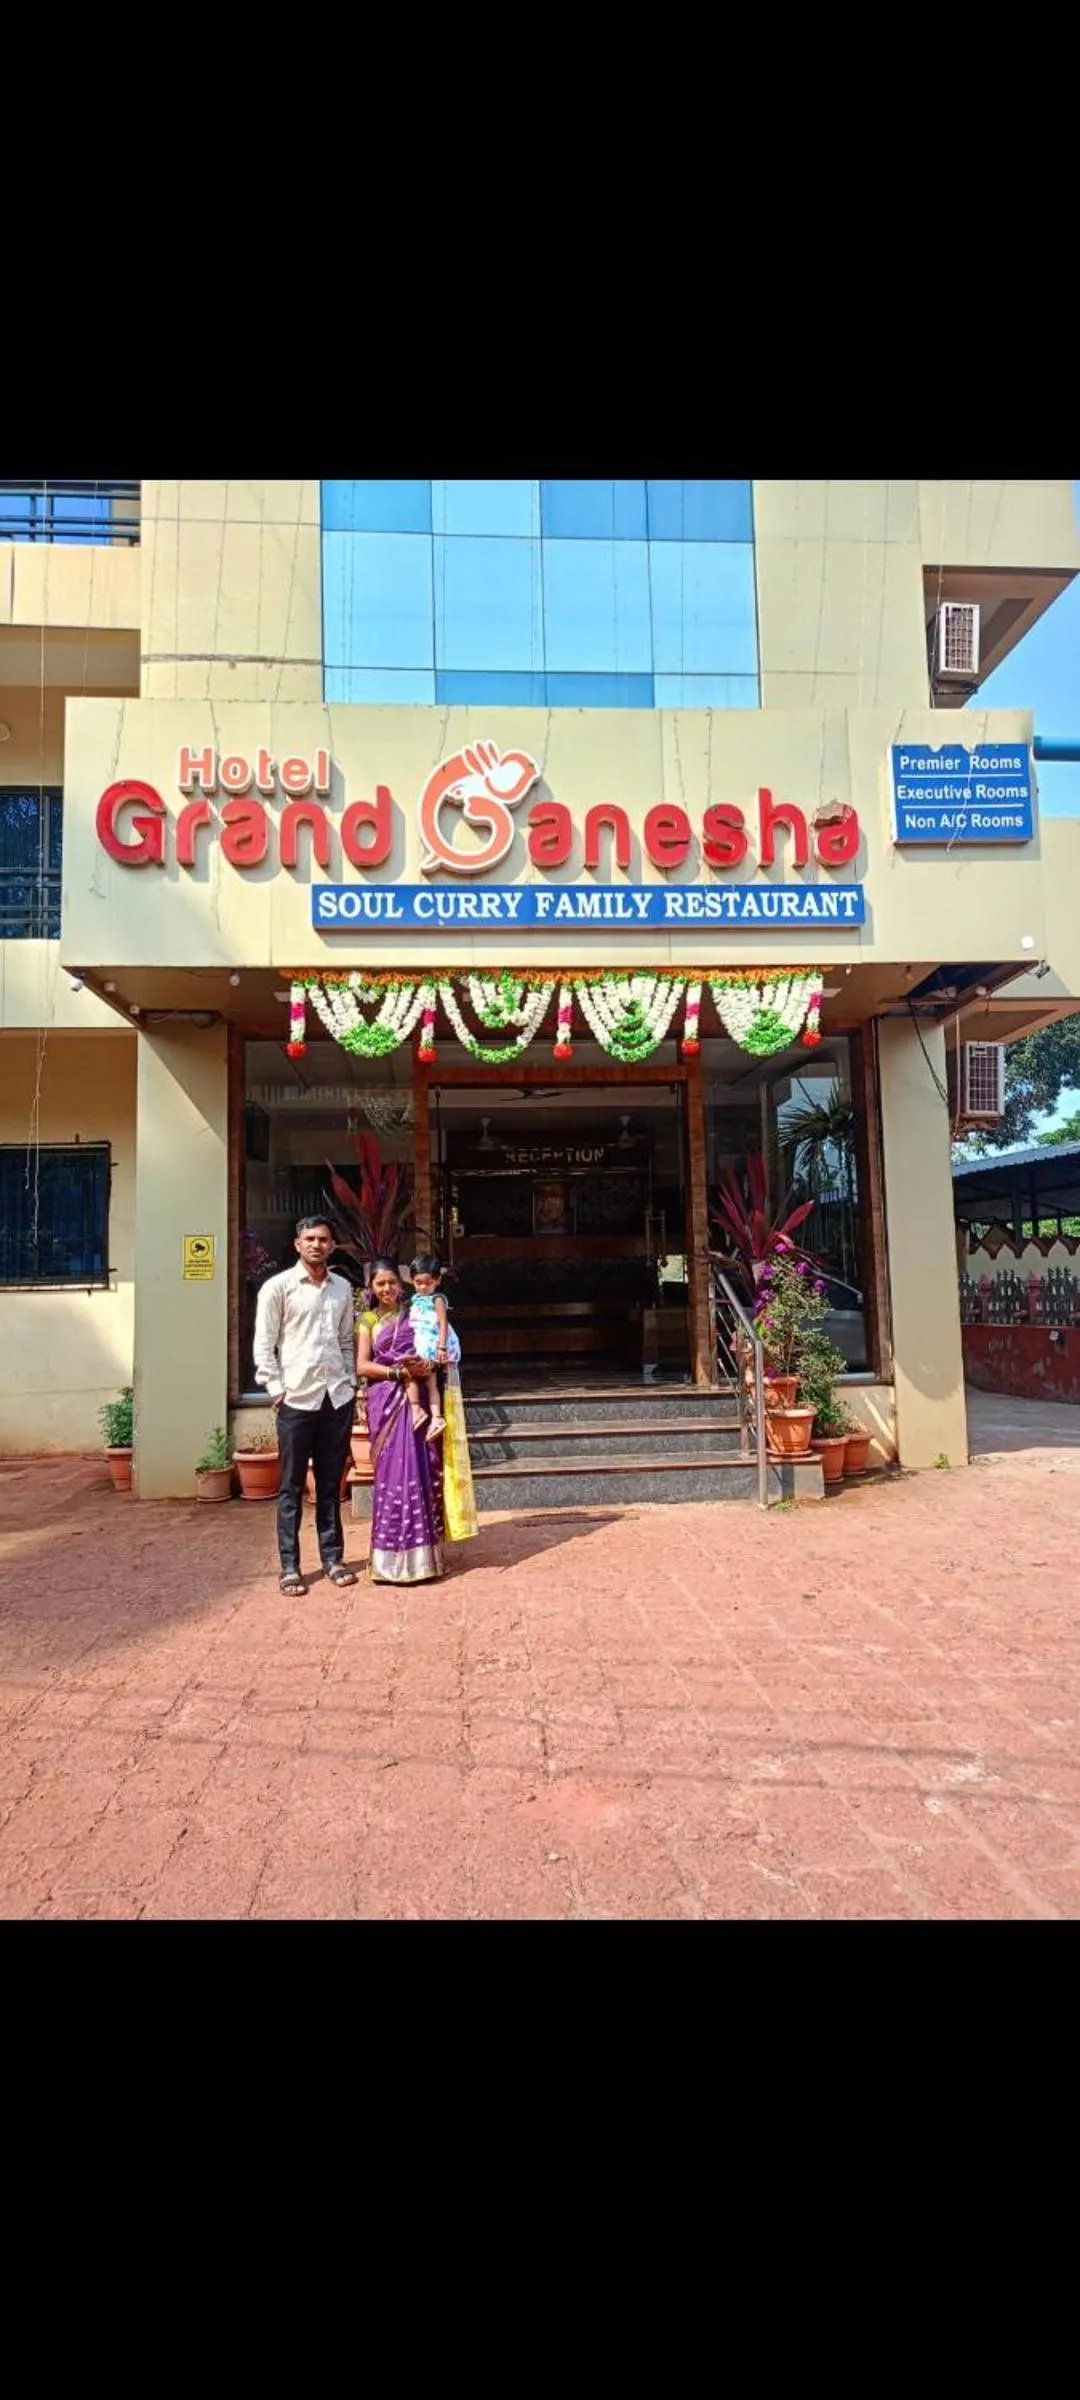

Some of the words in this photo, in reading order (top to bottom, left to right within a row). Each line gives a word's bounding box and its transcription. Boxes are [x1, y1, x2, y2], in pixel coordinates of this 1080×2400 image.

[178, 746, 331, 794] Hotel
[900, 755, 960, 770] Premier
[969, 755, 1022, 769] Rooms
[897, 784, 971, 799] Executive
[975, 784, 1028, 799] Rooms
[96, 779, 393, 866] Grand
[418, 740, 860, 874] Ganesha
[905, 814, 936, 828] Non
[940, 814, 967, 828] A/C
[971, 813, 1023, 828] Rooms
[318, 892, 404, 918] SOUL
[413, 892, 522, 918] CURRY
[535, 892, 653, 918] FAMILY
[664, 891, 859, 918] RESTAURANT
[505, 1147, 605, 1163] RECEPTION
